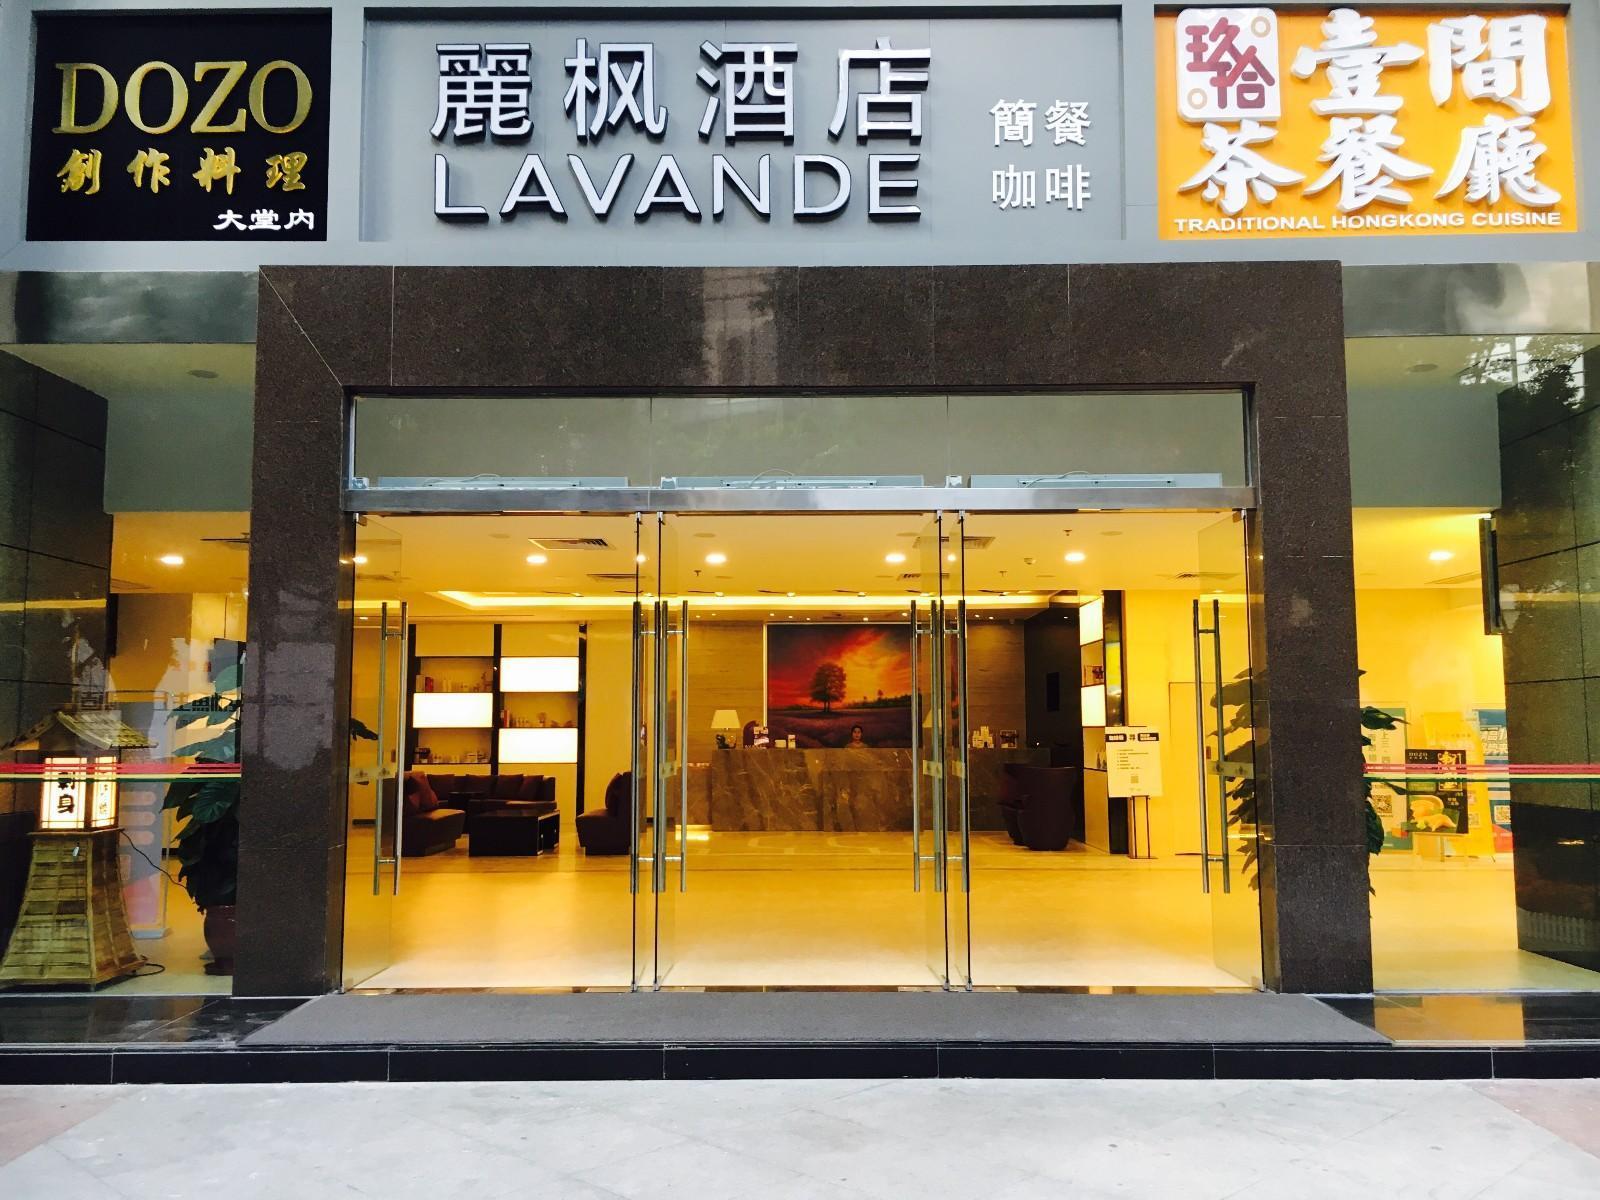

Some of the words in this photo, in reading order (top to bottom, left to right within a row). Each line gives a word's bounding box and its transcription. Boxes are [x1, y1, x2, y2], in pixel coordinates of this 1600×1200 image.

[430, 38, 931, 142] 麗枫酒店
[1290, 9, 1550, 115] 壹間
[52, 60, 312, 134] DOZO
[990, 99, 1091, 147] 簡餐
[56, 147, 308, 195] 創作料理
[434, 153, 921, 220] LAVANDE
[992, 164, 1091, 211] 咖啡
[1178, 114, 1562, 215] 茶餐廳
[1175, 216, 1324, 232] TRADITIONAL
[1332, 213, 1465, 229] HONGKONG
[1471, 212, 1562, 227] CUISINE
